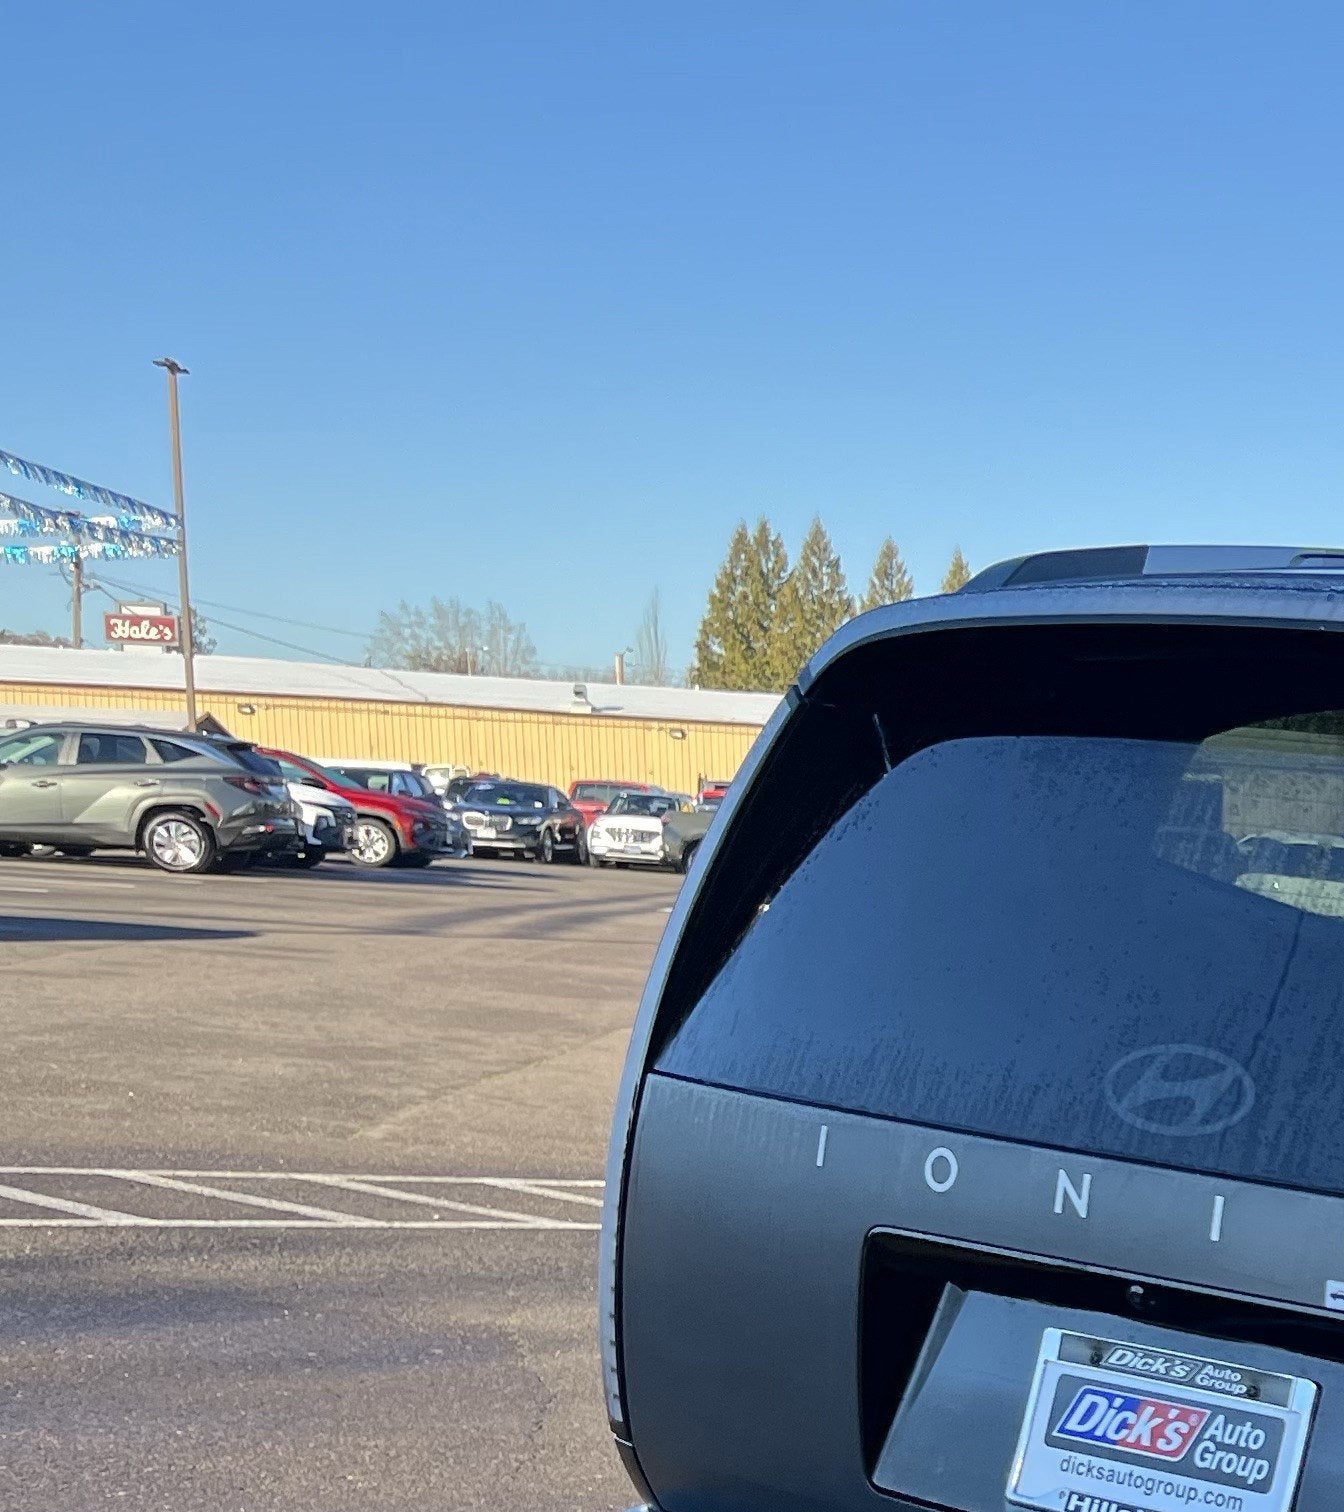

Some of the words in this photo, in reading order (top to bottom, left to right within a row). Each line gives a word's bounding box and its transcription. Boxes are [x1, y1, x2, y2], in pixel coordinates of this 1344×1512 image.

[109, 618, 173, 641] Hale's
[1108, 1349, 1191, 1378] Dick's
[1201, 1364, 1242, 1382] Auto
[1195, 1374, 1248, 1395] Group
[1065, 1393, 1190, 1451] Dick's
[1202, 1414, 1266, 1450] Auto
[1193, 1440, 1270, 1485] Group
[1060, 1455, 1243, 1512] dicksautogroup.com
